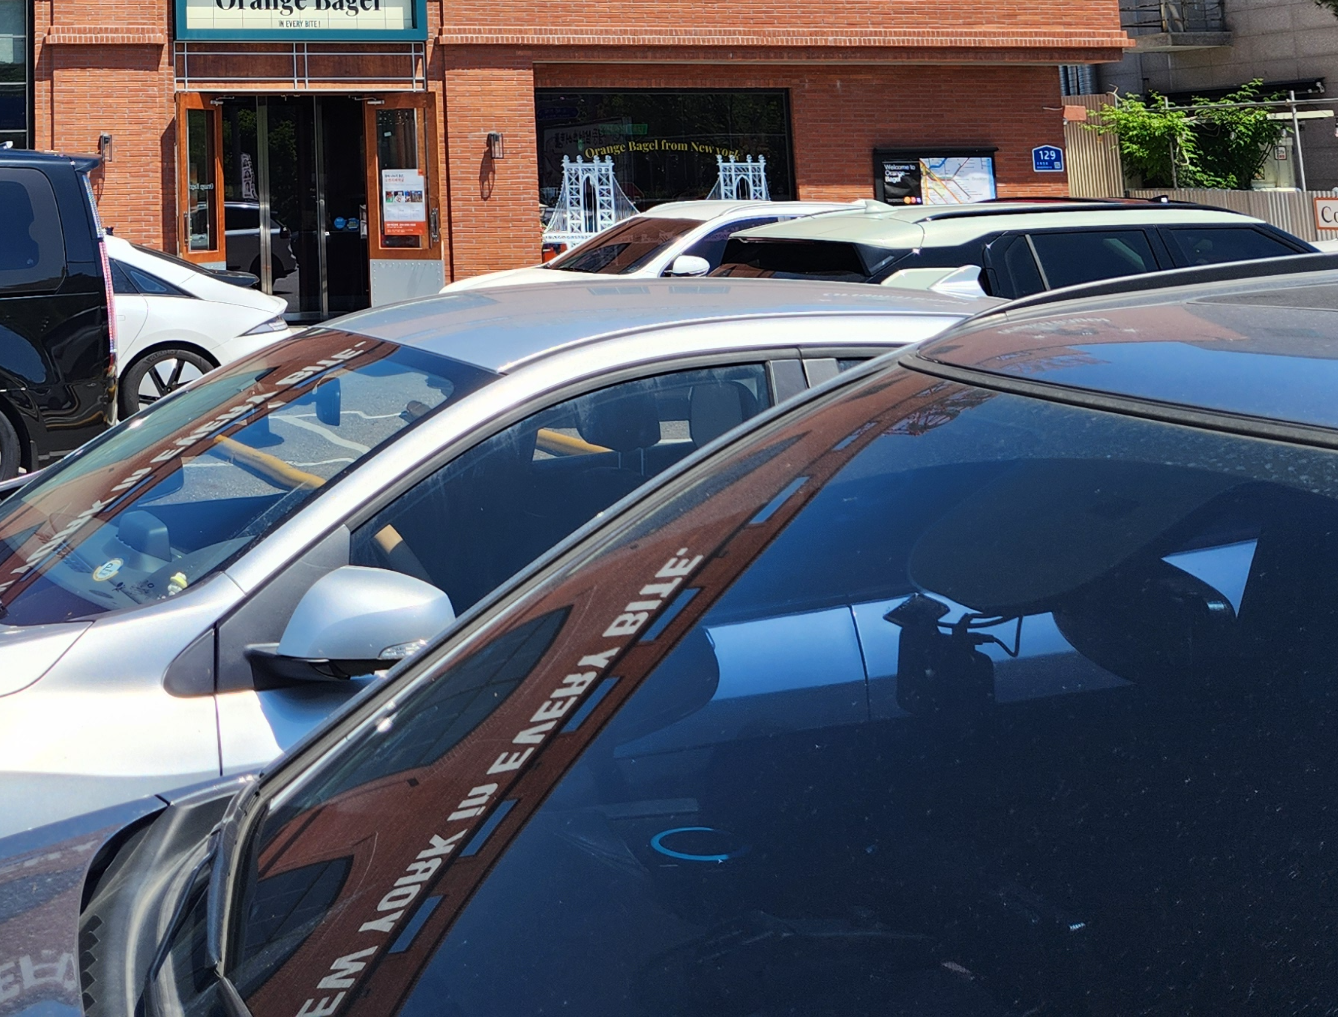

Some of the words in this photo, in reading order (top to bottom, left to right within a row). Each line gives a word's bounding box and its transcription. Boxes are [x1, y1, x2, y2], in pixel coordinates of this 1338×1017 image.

[285, 20, 303, 28] EVERY
[584, 143, 626, 159] Orange
[628, 139, 659, 154] Bagel
[661, 139, 688, 151] from
[690, 141, 715, 154] New
[1038, 150, 1056, 161] 129
